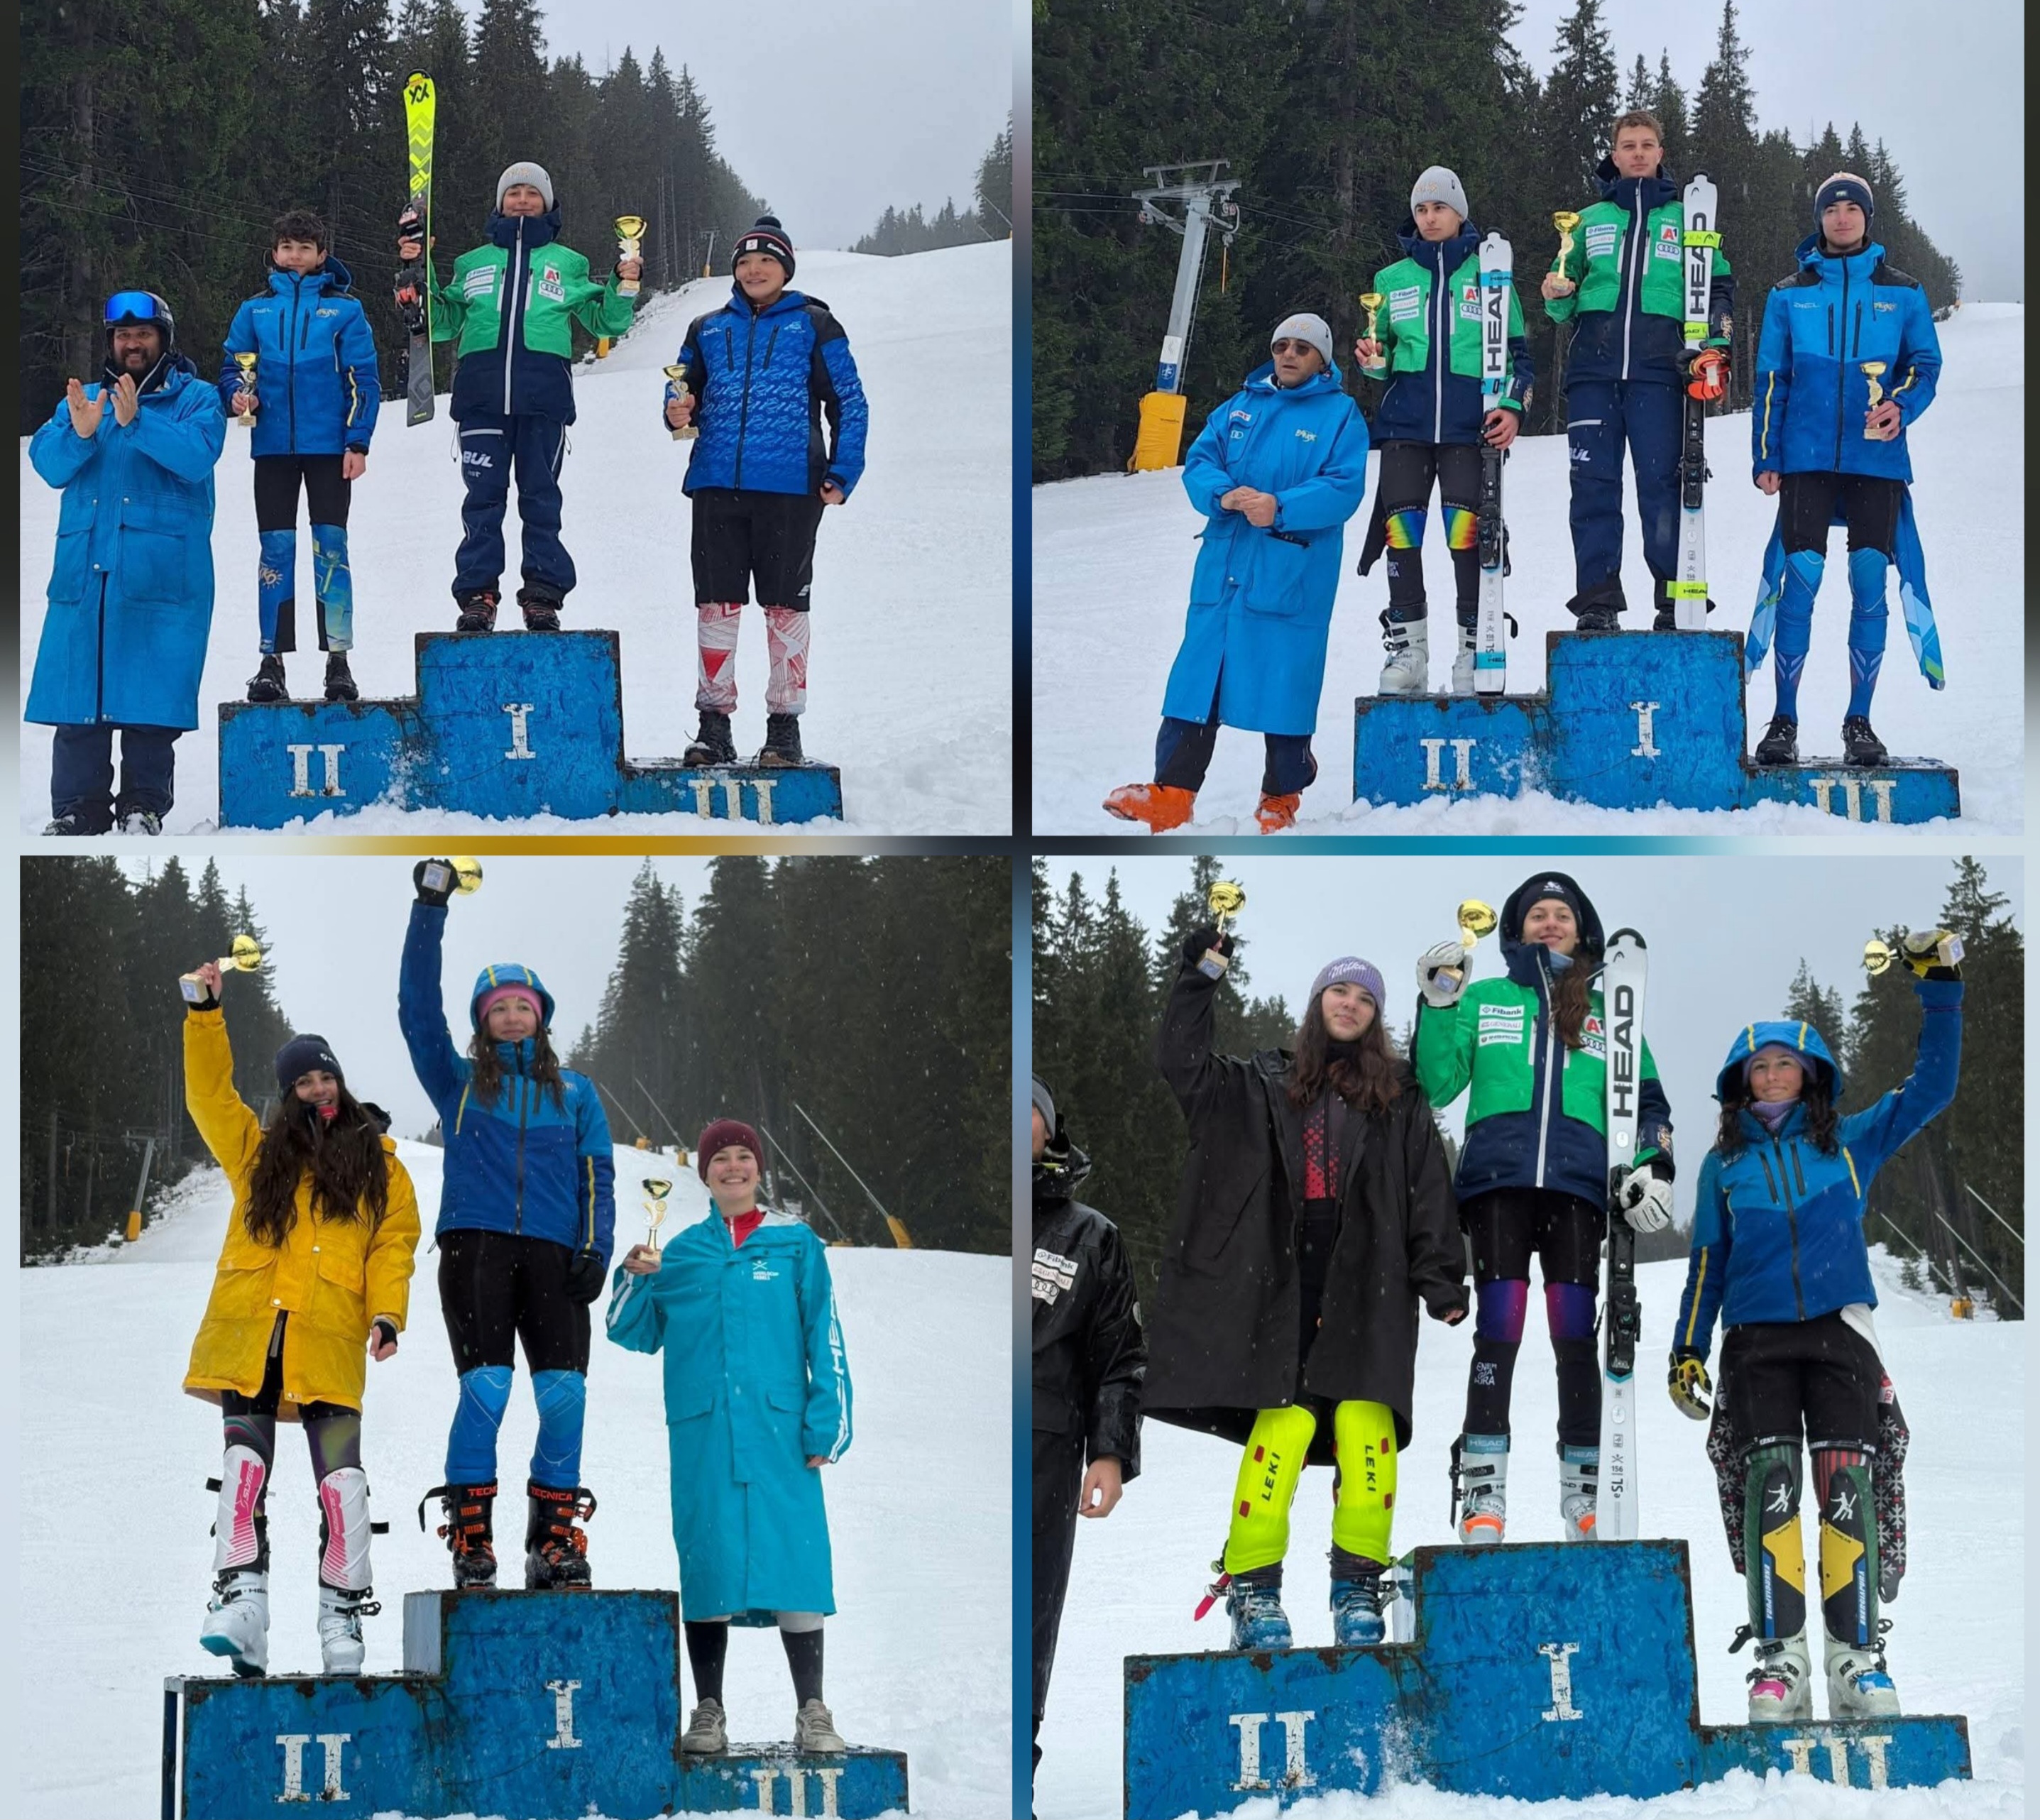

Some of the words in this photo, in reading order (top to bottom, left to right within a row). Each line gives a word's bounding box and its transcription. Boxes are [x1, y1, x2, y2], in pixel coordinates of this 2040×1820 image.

[1662, 228, 1677, 240] A1
[545, 269, 559, 282] A1
[1690, 212, 1706, 314] HEAD
[504, 703, 534, 759] I
[1630, 701, 1662, 757] I
[287, 745, 346, 796] II
[1420, 739, 1476, 790] II
[688, 779, 777, 825] III
[1809, 779, 1896, 823] III
[1328, 961, 1366, 980] Milka
[1492, 1007, 1521, 1016] Fibank
[1613, 985, 1634, 1118] HEAD
[467, 1484, 497, 1496] TECN
[530, 1486, 573, 1501] TECNICA
[1261, 1452, 1281, 1502] LEKI
[1365, 1445, 1376, 1492] LEKI
[1764, 1563, 1773, 1620] ENERGIAPURA
[1858, 1570, 1866, 1626] ENERGIAPURA
[1538, 1643, 1583, 1721] I
[547, 1679, 582, 1748] I
[275, 1733, 351, 1802] II
[1229, 1711, 1316, 1791] II
[751, 1768, 844, 1817] III
